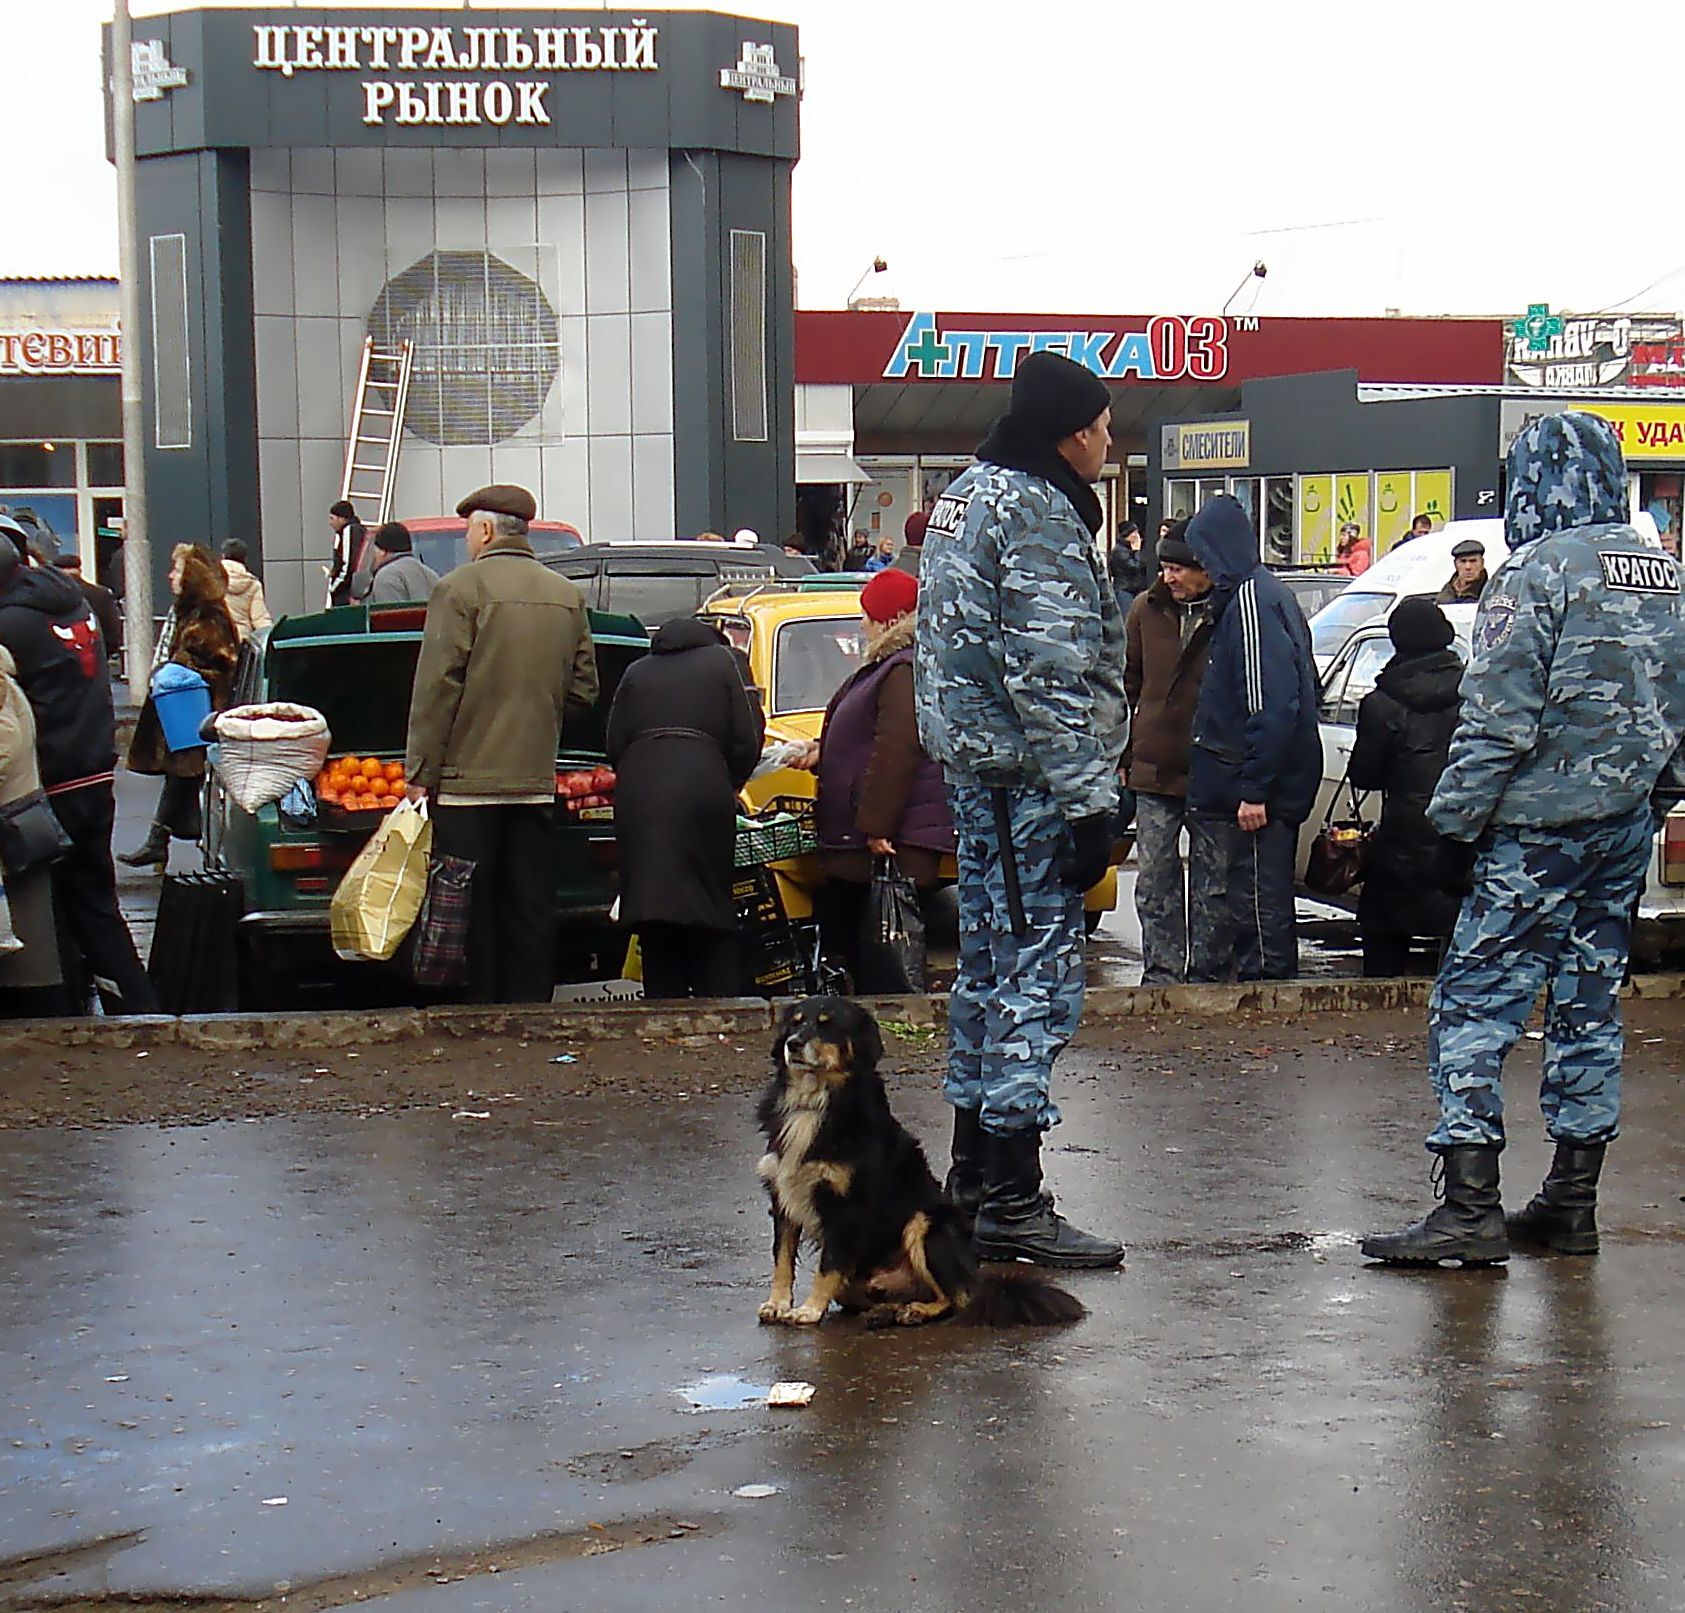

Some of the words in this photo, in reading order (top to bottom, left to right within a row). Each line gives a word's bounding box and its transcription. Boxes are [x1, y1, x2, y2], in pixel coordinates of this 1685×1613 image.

[252, 18, 659, 77] ЦЕНТРАЛЬНЫЙ
[361, 80, 551, 125] РЫНОК
[1182, 430, 1246, 461] СМЕСИТЕЛИ
[1636, 421, 1685, 448] УДА
[1603, 555, 1677, 589] КРАТОС
